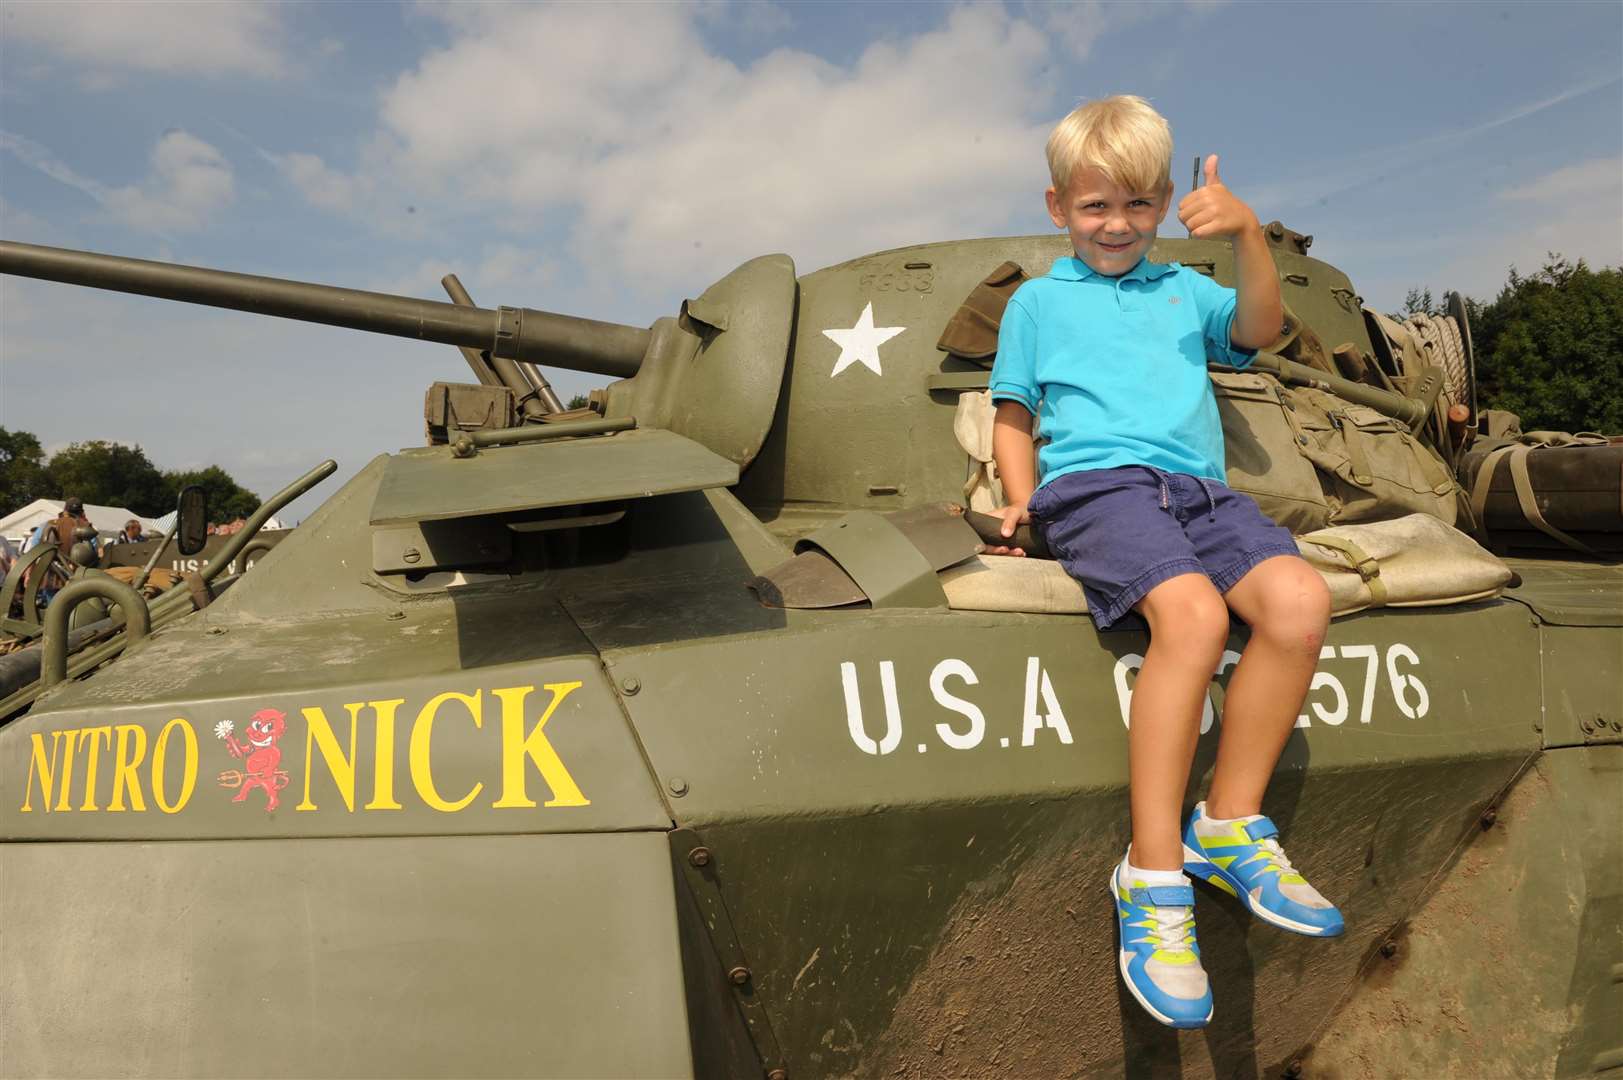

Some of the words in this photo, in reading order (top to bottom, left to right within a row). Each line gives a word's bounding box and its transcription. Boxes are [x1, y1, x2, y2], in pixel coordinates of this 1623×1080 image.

[20, 718, 200, 815] NITRO
[296, 680, 592, 814] NICK
[840, 656, 1074, 756] U.S.A
